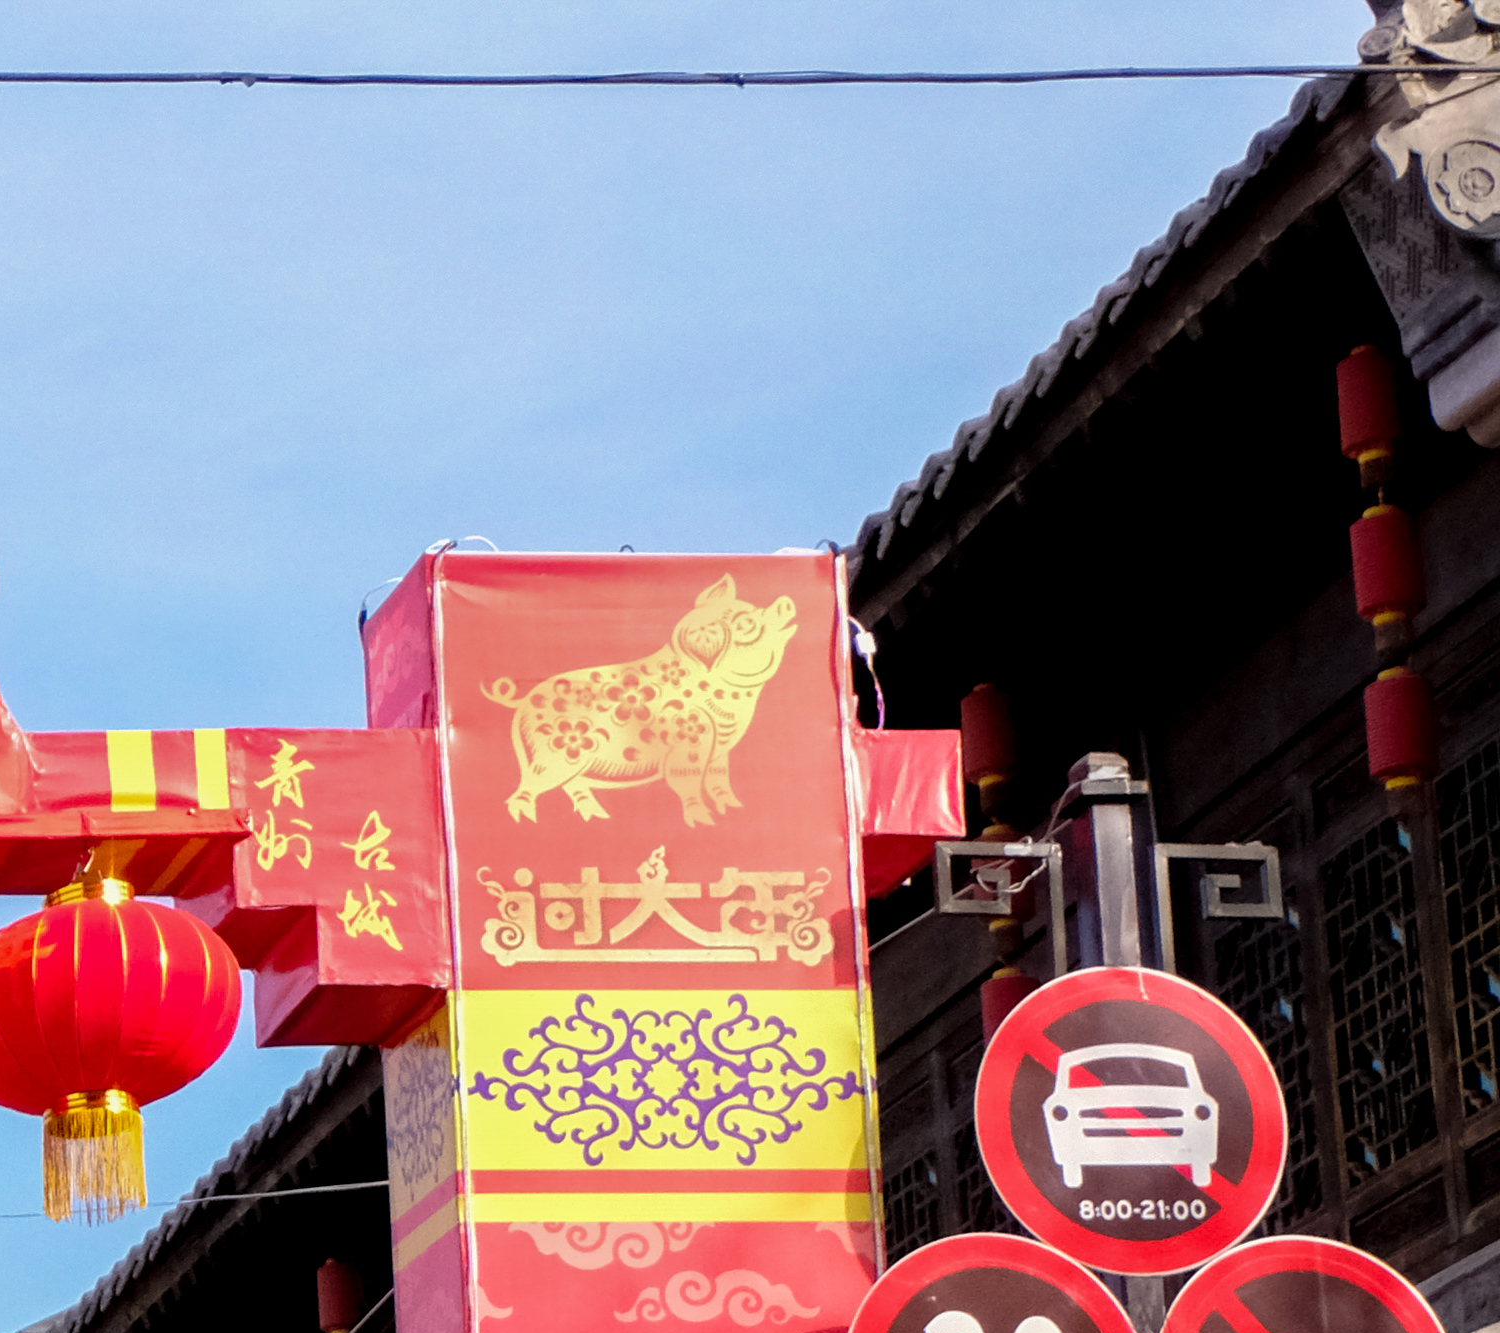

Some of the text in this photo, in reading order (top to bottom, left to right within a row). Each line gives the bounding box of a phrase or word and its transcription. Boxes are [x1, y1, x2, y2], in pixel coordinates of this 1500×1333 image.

[251, 738, 315, 872] 青州
[335, 809, 404, 952] 古城
[490, 872, 820, 966] 过大年
[1079, 1199, 1207, 1220] 8:00-21:00
